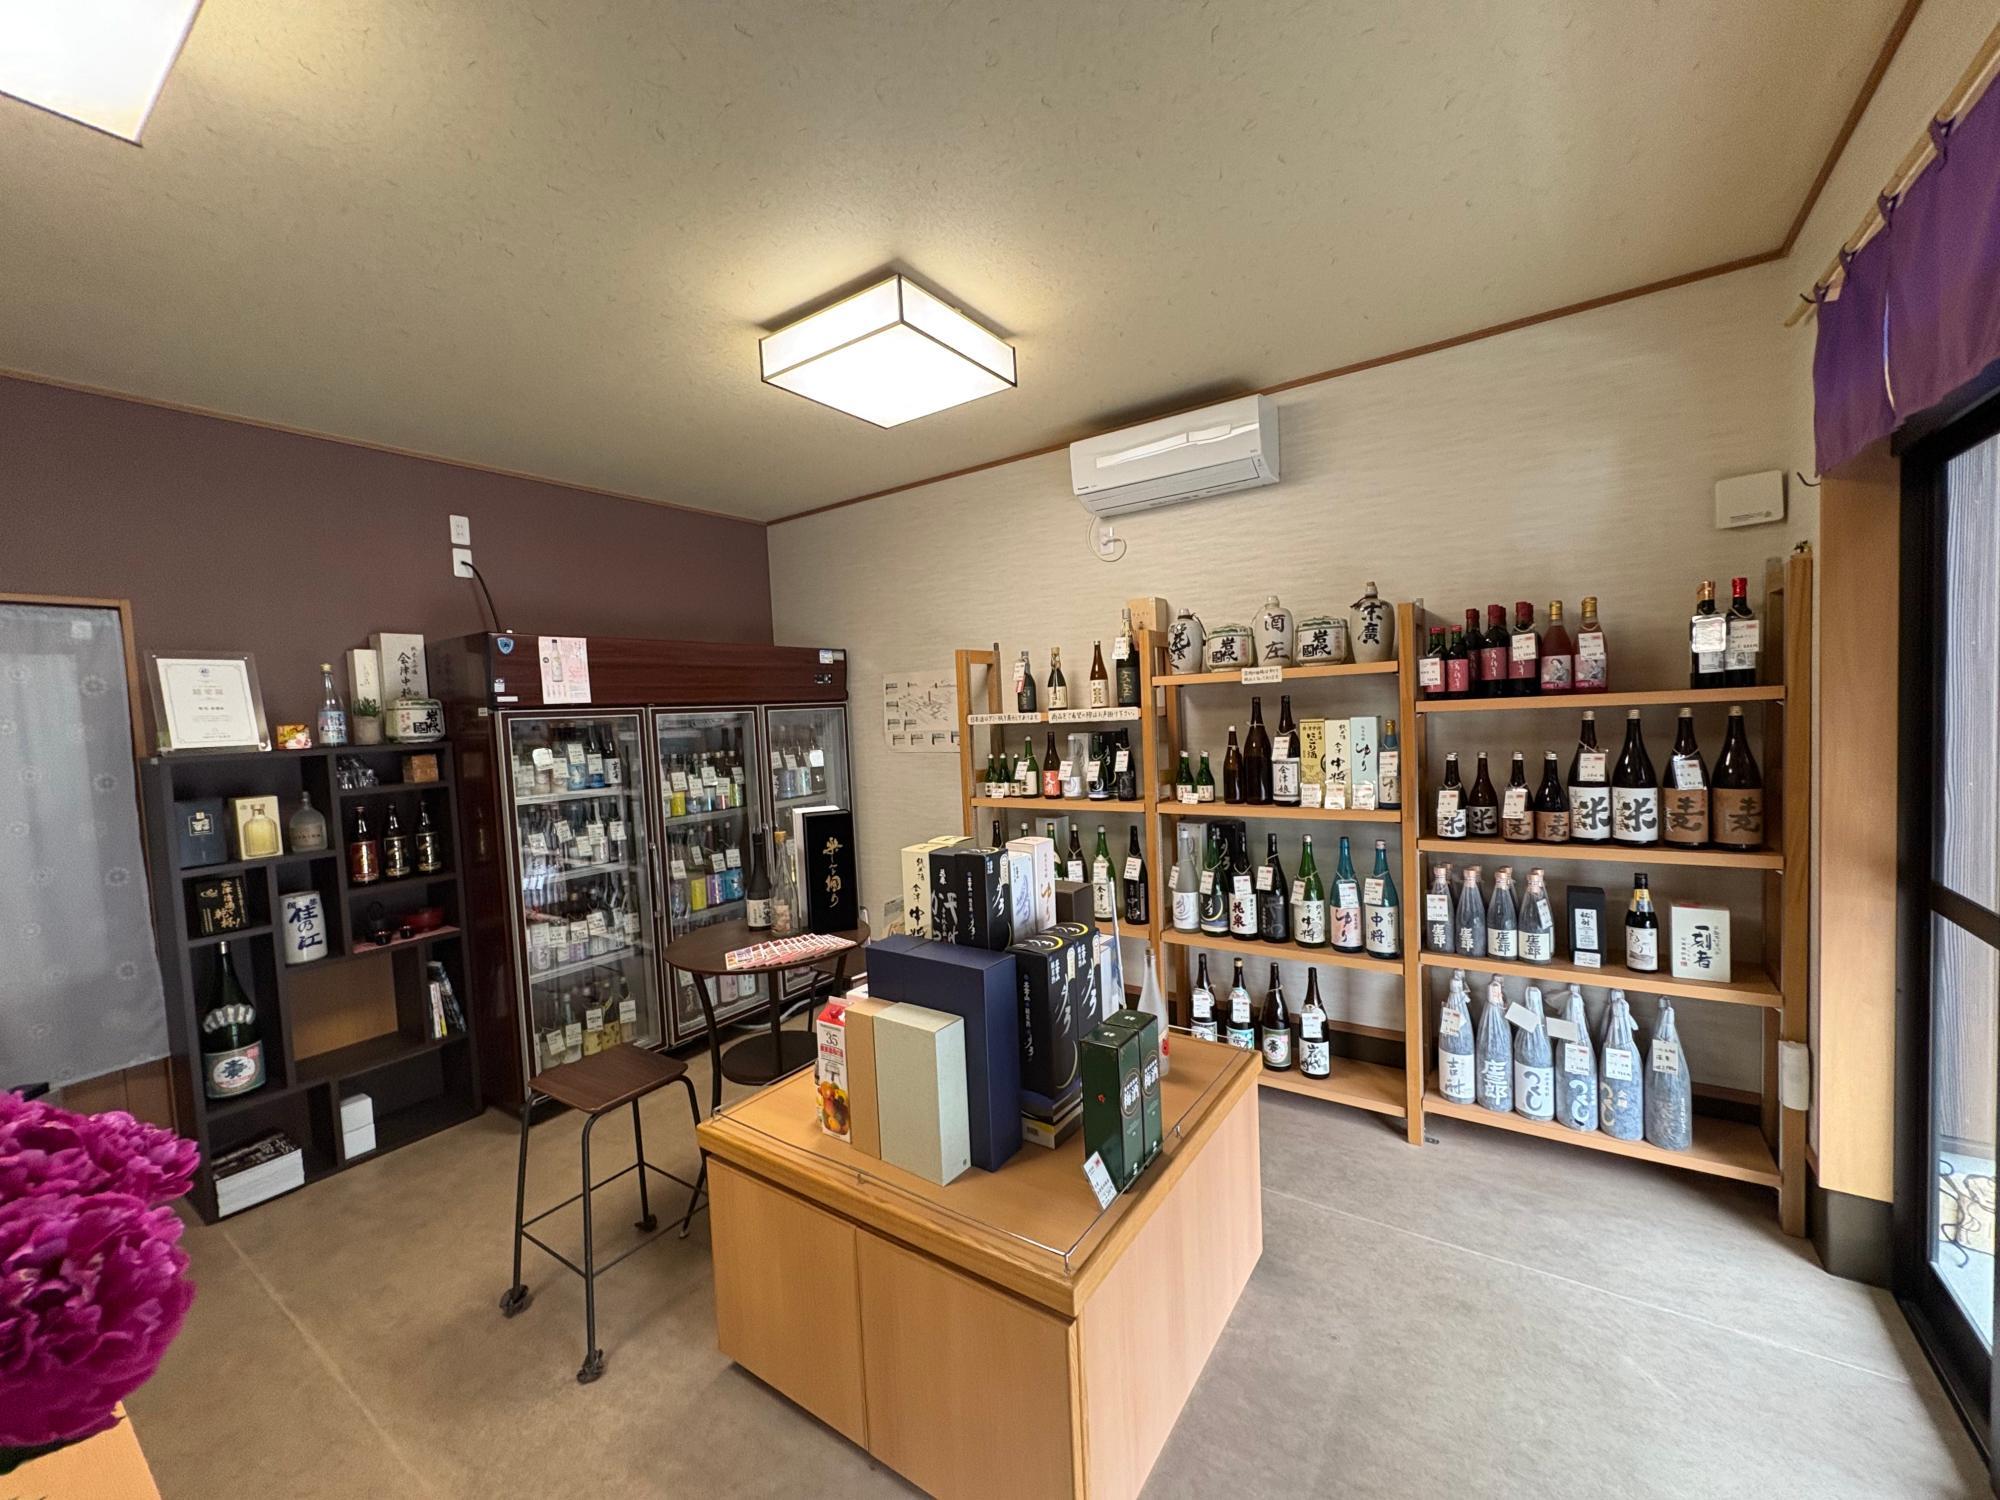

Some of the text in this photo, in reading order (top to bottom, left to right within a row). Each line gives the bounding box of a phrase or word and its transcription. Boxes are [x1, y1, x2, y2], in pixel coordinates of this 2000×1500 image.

[1357, 602, 1383, 645] 末廣
[397, 652, 412, 698] 会津中将
[1307, 732, 1318, 759] にごり酒
[1355, 743, 1371, 772] ゆり
[1279, 765, 1290, 793] 会津娘
[1473, 808, 1496, 832] 米
[1580, 797, 1611, 829] 米
[1622, 797, 1657, 832] 米
[1232, 902, 1246, 928] 花泉
[1335, 908, 1352, 943] ゆり
[1370, 911, 1385, 944] 中将
[1691, 925, 1713, 969] 一刻者
[826, 1031, 839, 1047] 35
[1481, 1059, 1508, 1106] 庄三郎
